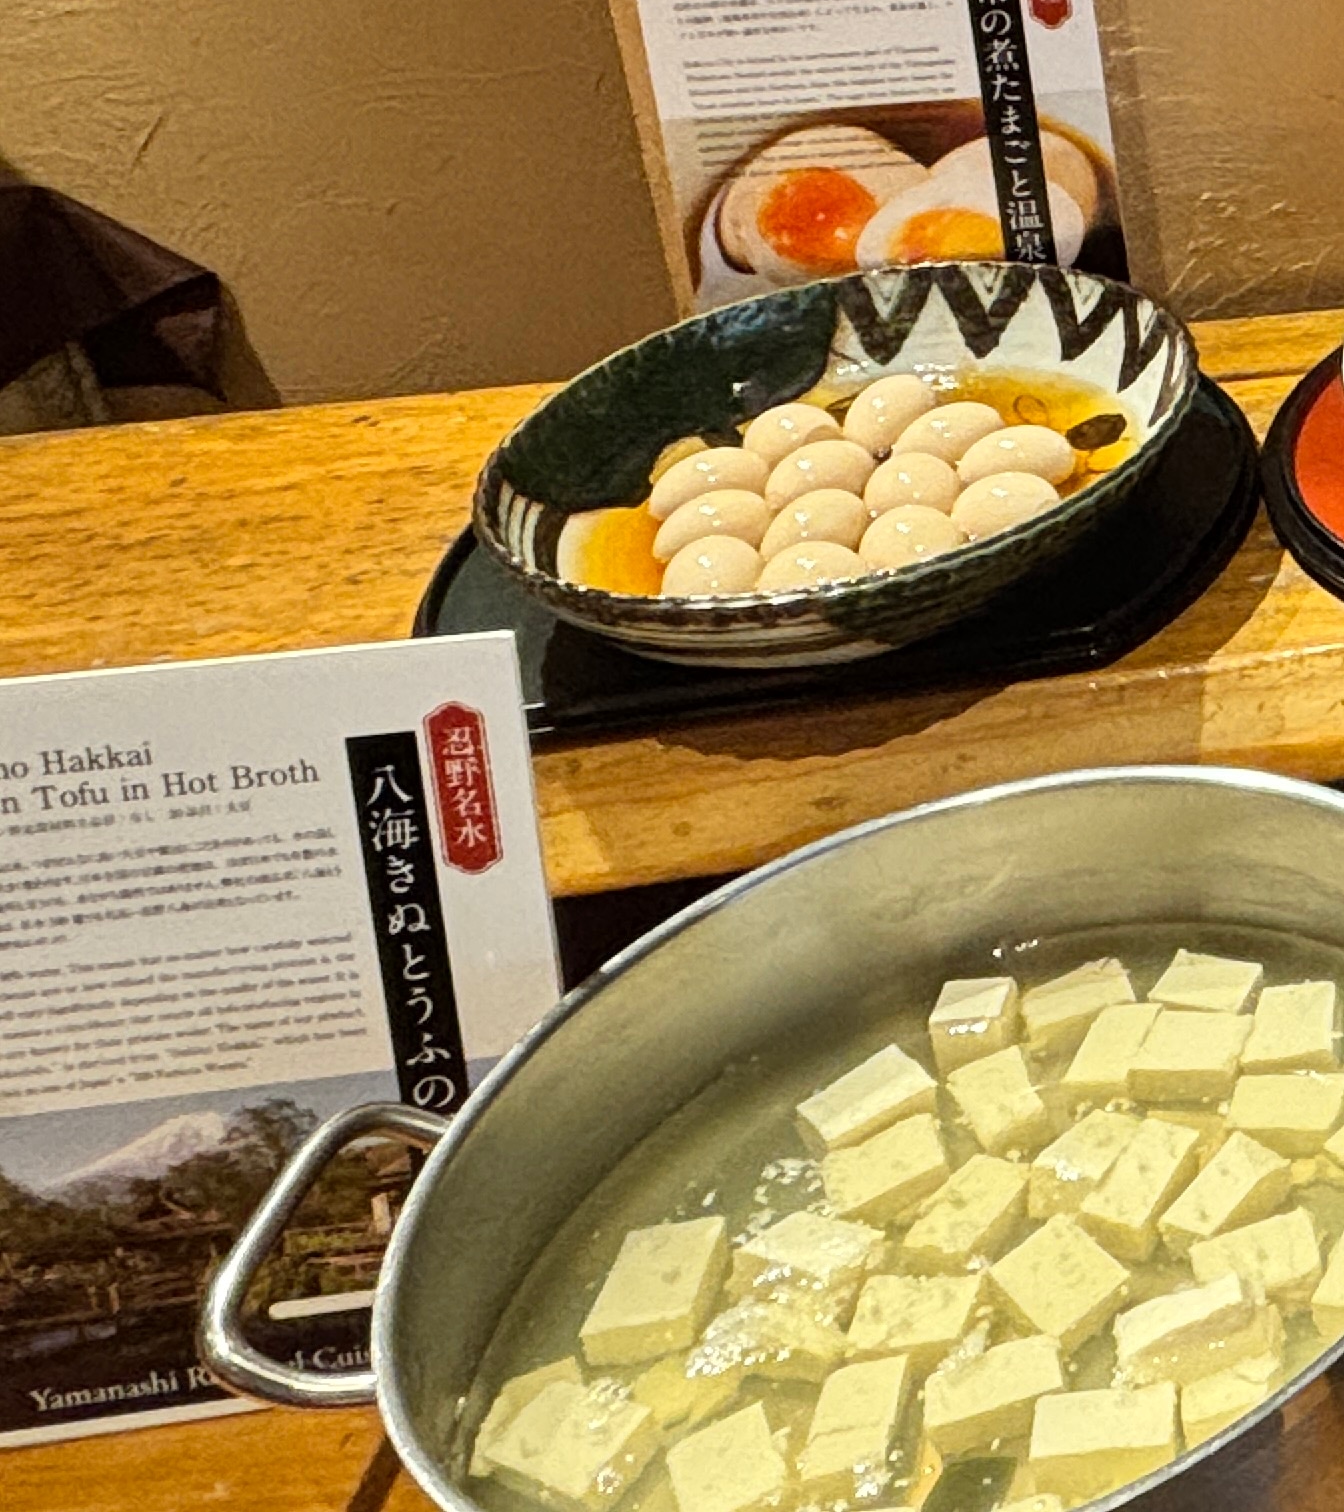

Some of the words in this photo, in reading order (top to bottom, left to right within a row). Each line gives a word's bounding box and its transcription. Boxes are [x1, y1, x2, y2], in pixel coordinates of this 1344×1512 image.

[40, 740, 153, 775] Hakkai
[31, 781, 110, 810] Tofu
[120, 777, 150, 801] in
[161, 771, 219, 797] Hot
[231, 758, 321, 790] Broth
[441, 726, 488, 849] 忍野名水
[366, 764, 457, 1108] 八海きぬとうふの
[29, 1369, 179, 1412] Yamanashi
